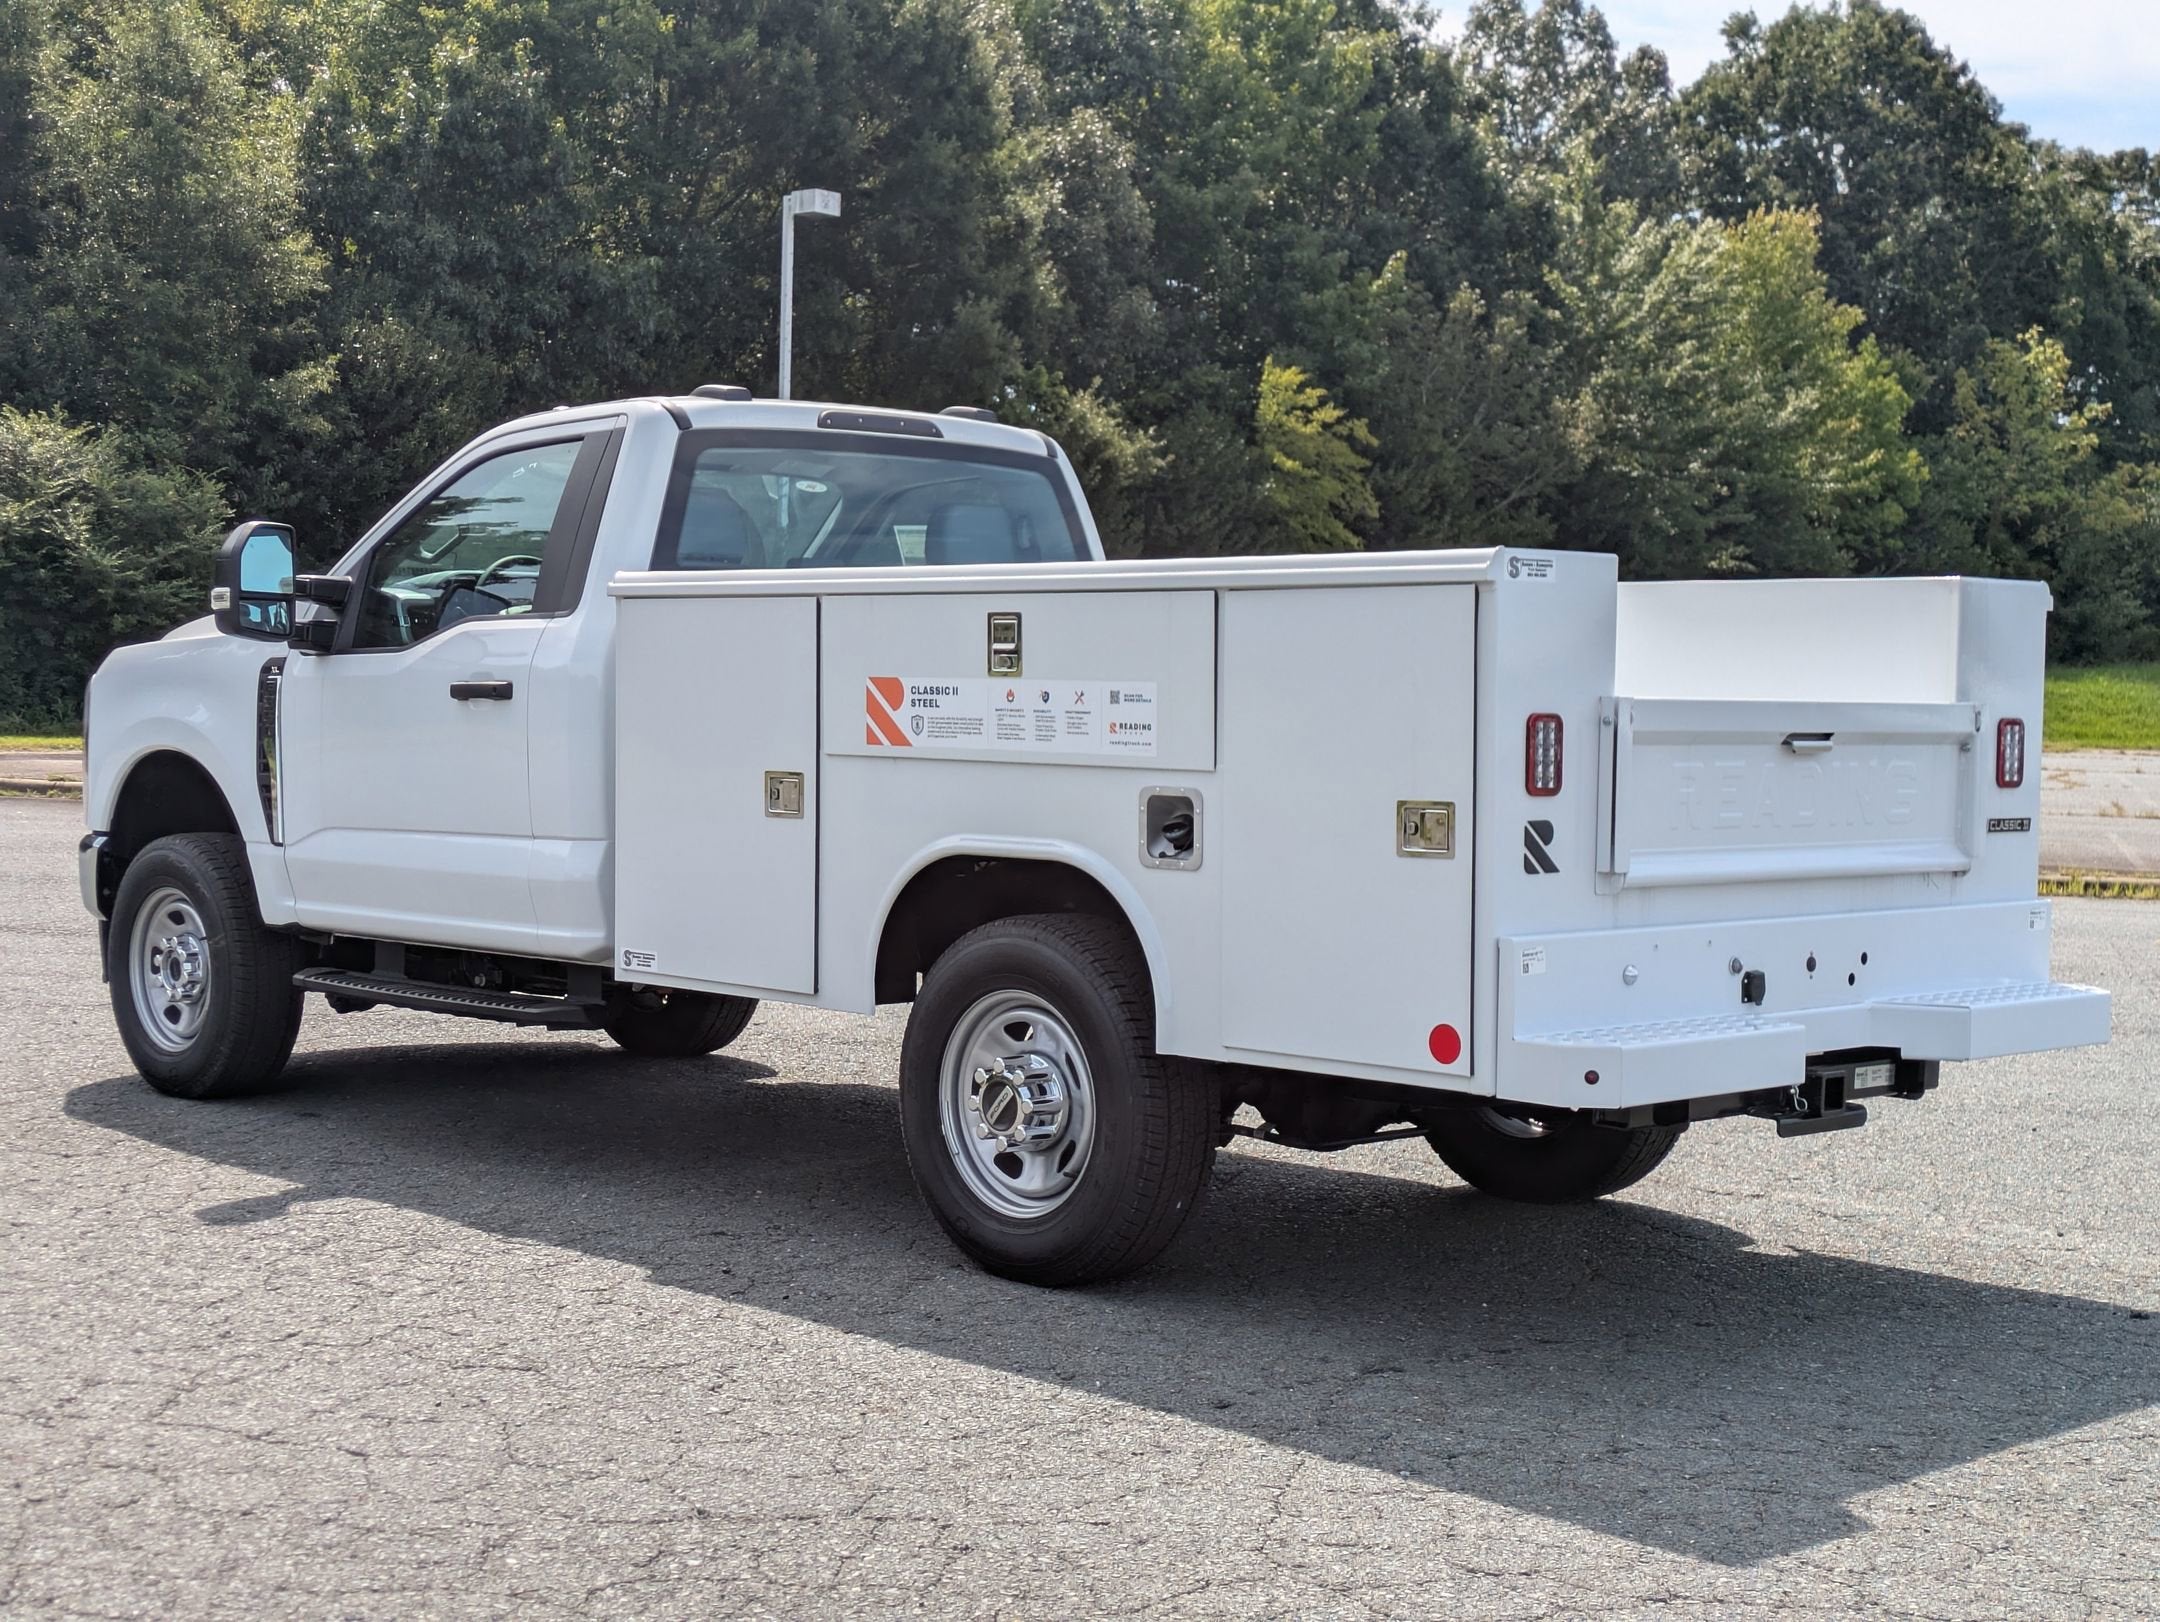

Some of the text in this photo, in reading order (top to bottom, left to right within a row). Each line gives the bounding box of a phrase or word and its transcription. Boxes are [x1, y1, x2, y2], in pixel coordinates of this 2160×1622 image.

[910, 686, 959, 696] CLASSIC II
[910, 698, 940, 708] STEEL
[1119, 723, 1152, 731] READING
[1669, 760, 1918, 832] READING
[1990, 820, 2021, 831] CLASSIC
[990, 1092, 1009, 1119] FORD
